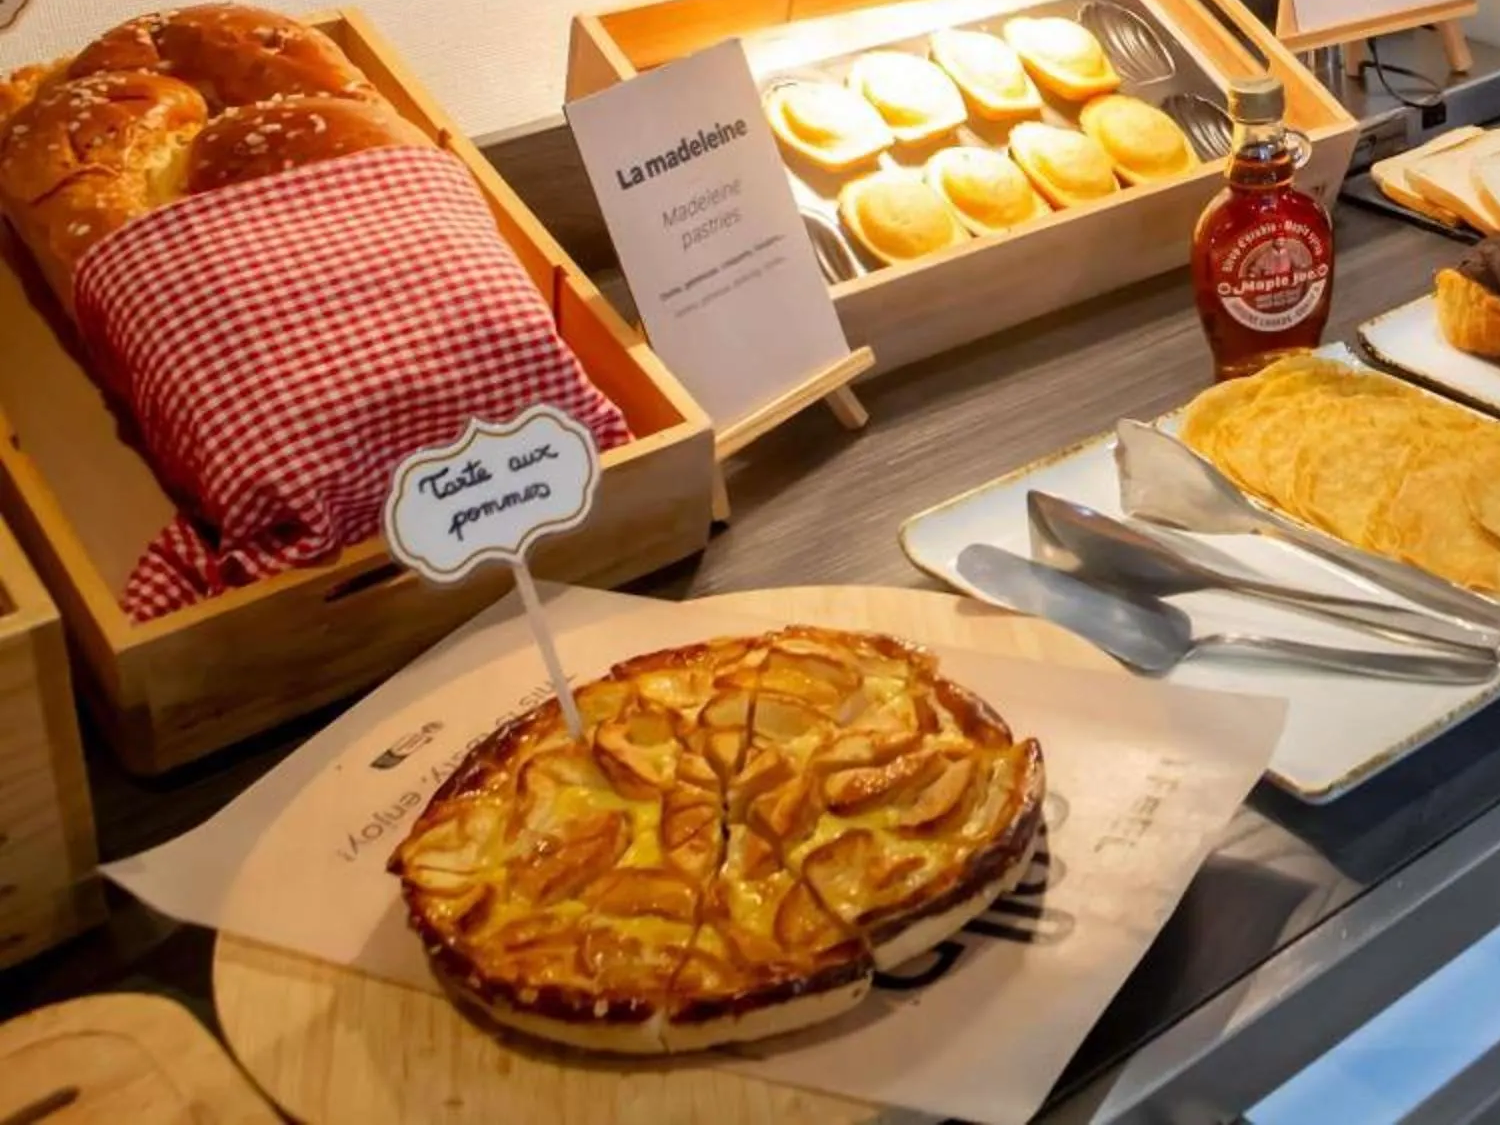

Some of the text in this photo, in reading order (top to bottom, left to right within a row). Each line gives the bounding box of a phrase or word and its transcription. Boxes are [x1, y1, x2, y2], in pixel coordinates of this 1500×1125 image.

[616, 118, 748, 191] La madeleine
[661, 178, 743, 230] Madeleine
[680, 207, 743, 252] pastries
[418, 443, 559, 500] Tarte aux
[448, 482, 551, 542] pommes
